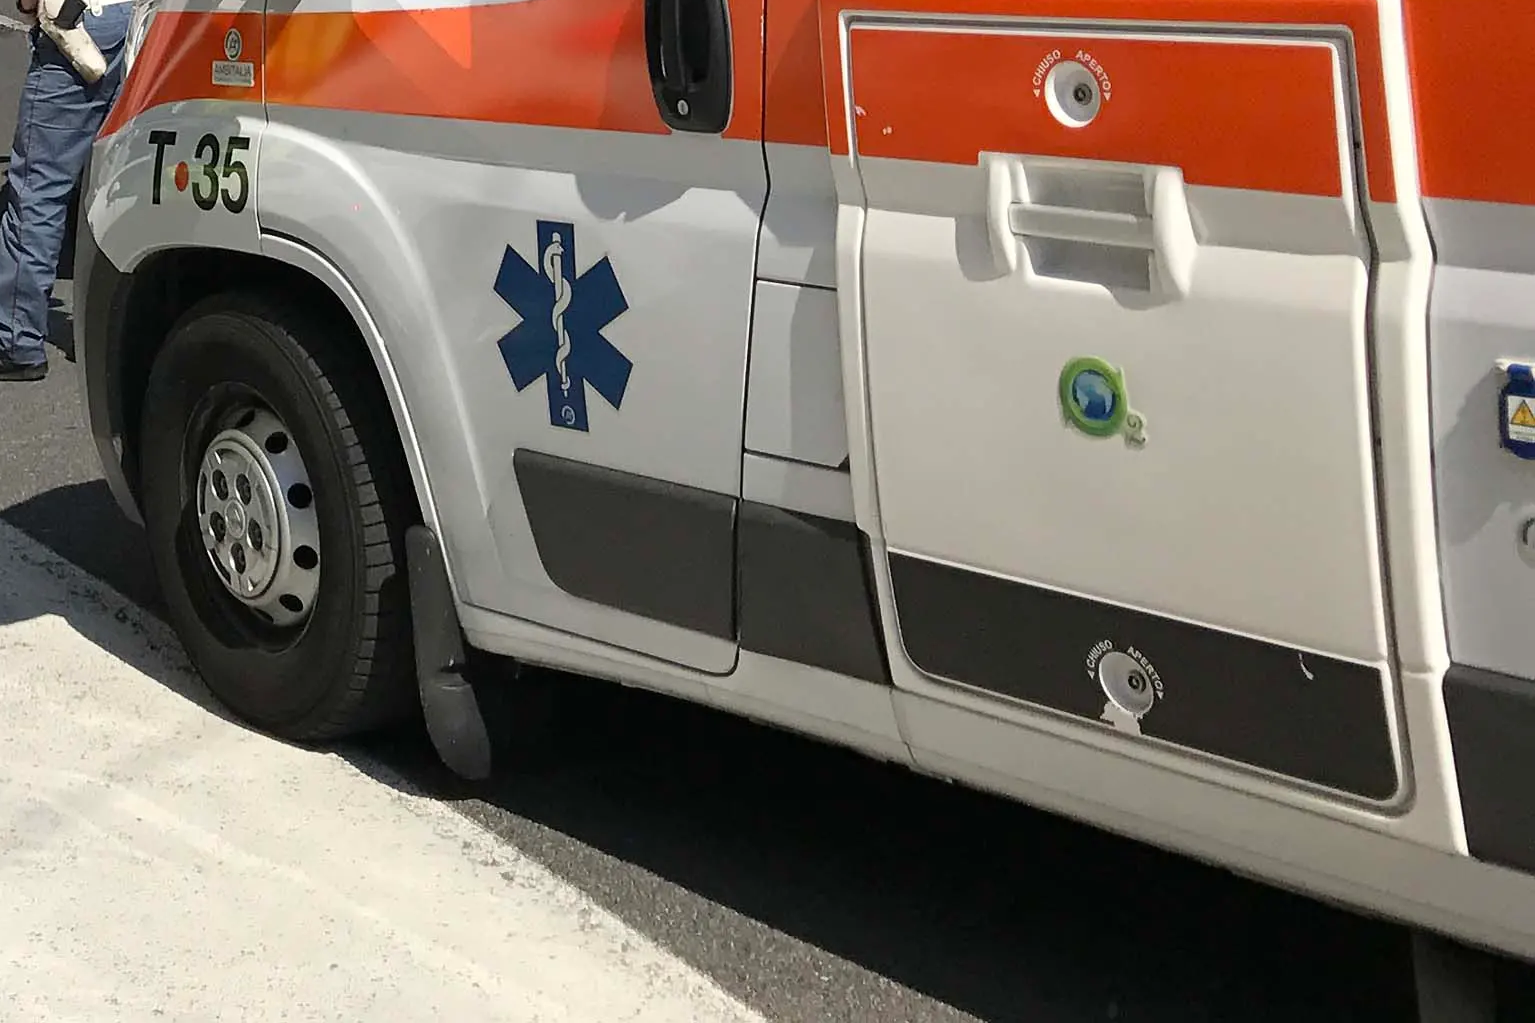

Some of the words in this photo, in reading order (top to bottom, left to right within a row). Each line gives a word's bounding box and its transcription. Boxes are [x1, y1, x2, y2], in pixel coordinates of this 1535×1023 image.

[1032, 49, 1061, 86] CHIUSO
[1075, 50, 1111, 90] APERTO
[1086, 639, 1113, 668] CHIUSO
